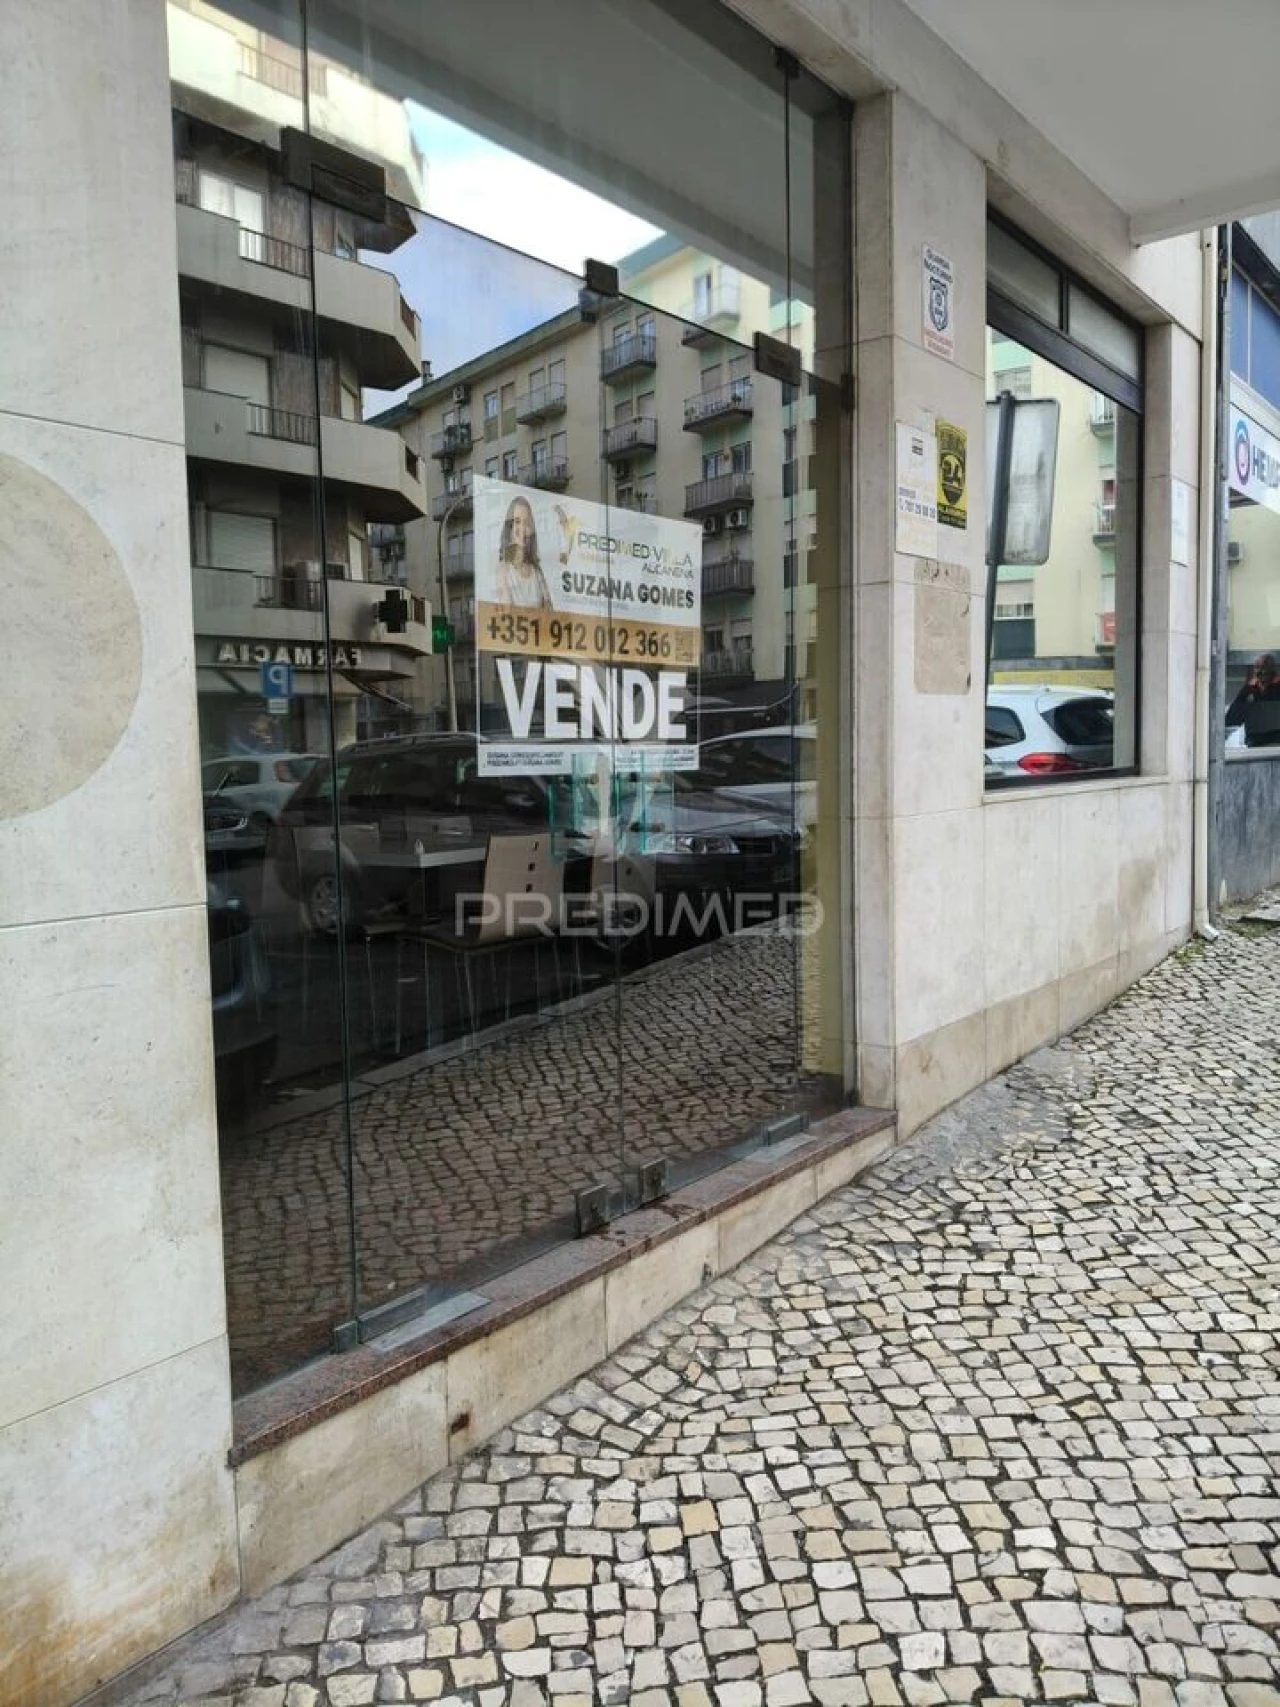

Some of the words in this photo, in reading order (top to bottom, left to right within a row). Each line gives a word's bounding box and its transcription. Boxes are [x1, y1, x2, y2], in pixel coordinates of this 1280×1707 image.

[577, 531, 650, 559] PREDIMED
[561, 571, 634, 602] SUZANA
[637, 582, 694, 609] GOMES
[487, 614, 540, 647] +351
[550, 619, 587, 651] 912
[594, 624, 630, 655] 012
[635, 629, 672, 658] 366
[495, 656, 688, 740] VENDE
